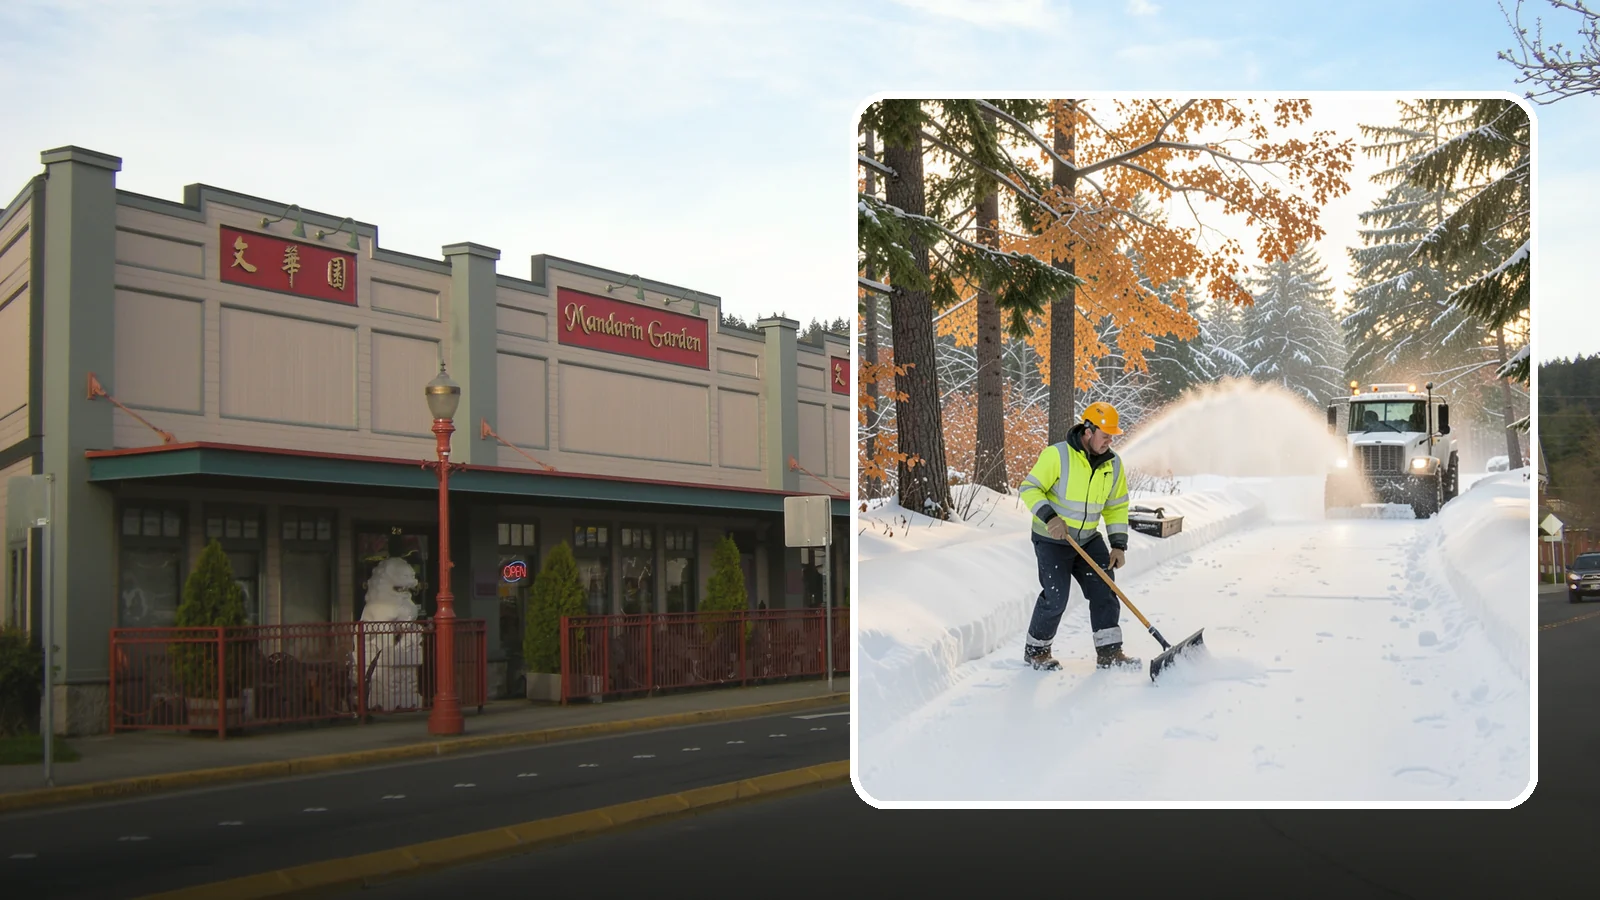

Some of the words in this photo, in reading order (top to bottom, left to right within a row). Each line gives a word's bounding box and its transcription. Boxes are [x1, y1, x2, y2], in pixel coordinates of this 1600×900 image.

[231, 236, 346, 291] 文華園
[564, 302, 644, 340] Mandarin
[648, 320, 702, 352] Garden
[503, 565, 526, 578] OPEN
